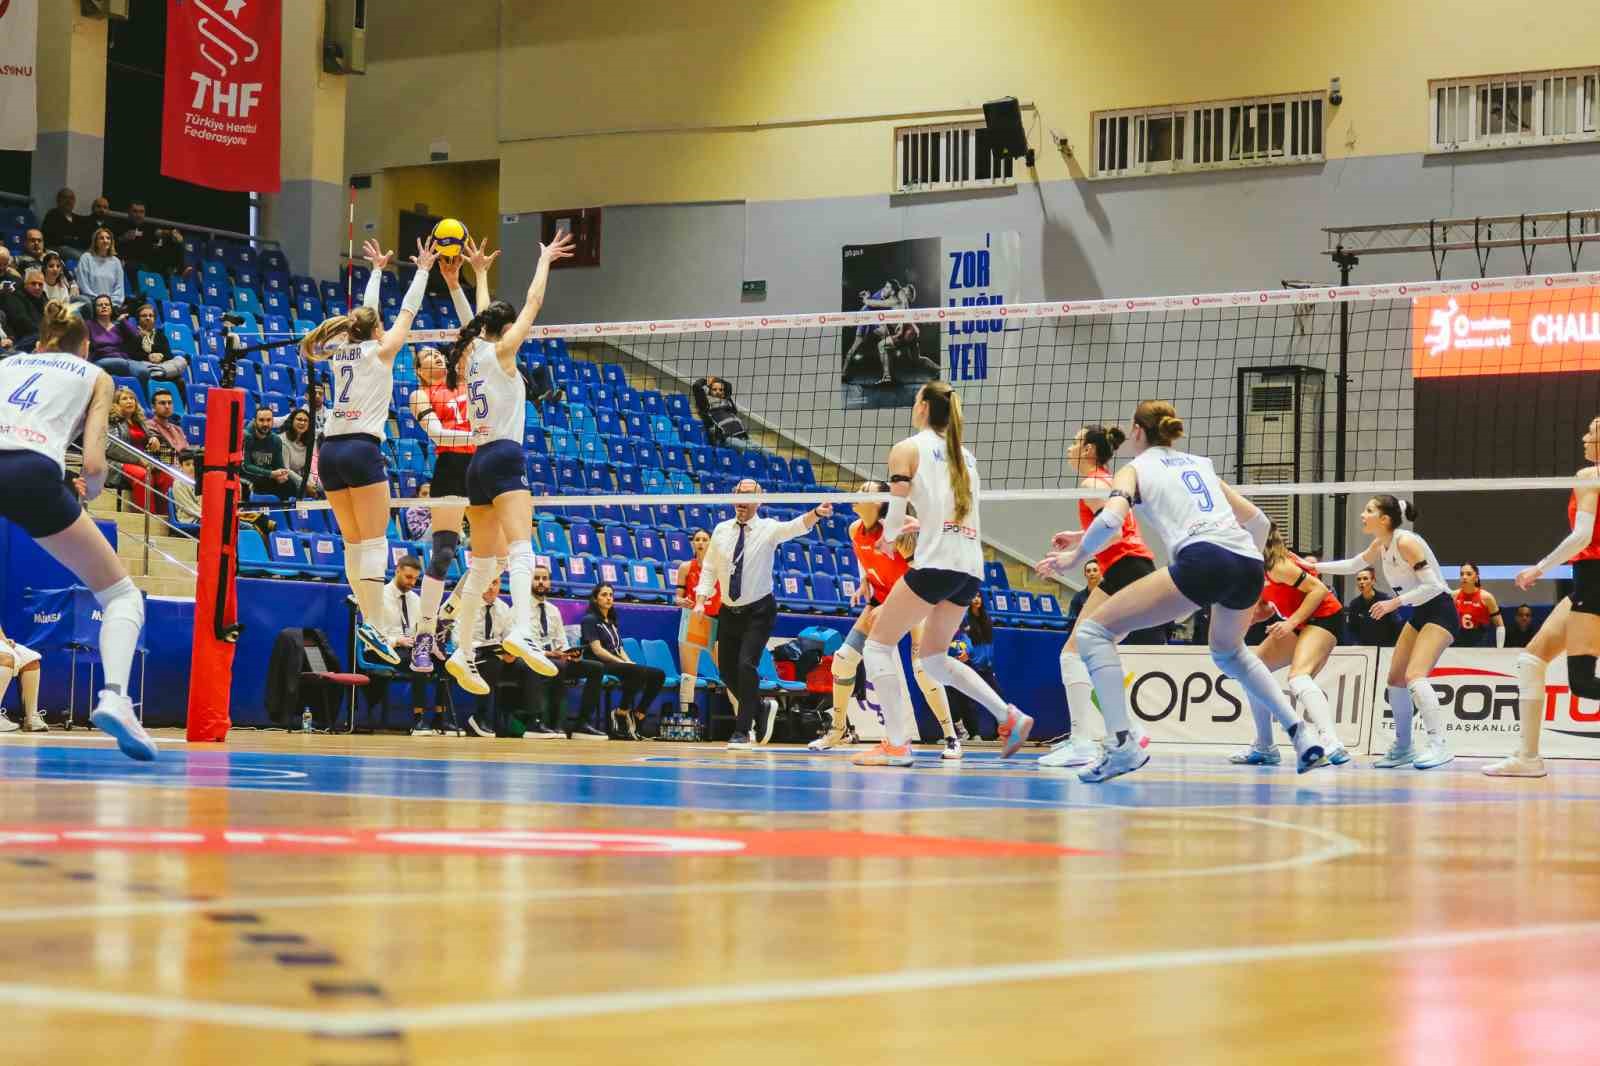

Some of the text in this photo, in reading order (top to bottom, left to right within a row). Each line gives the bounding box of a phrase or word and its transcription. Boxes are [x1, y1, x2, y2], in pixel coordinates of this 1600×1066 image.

[191, 71, 263, 118] THF
[184, 112, 225, 131] Türkiye
[949, 249, 990, 289] ZOR
[948, 342, 988, 382] YEN
[7, 371, 43, 411] 4
[339, 365, 354, 403] 2
[1181, 470, 1214, 512] 9
[1462, 614, 1474, 629] 6
